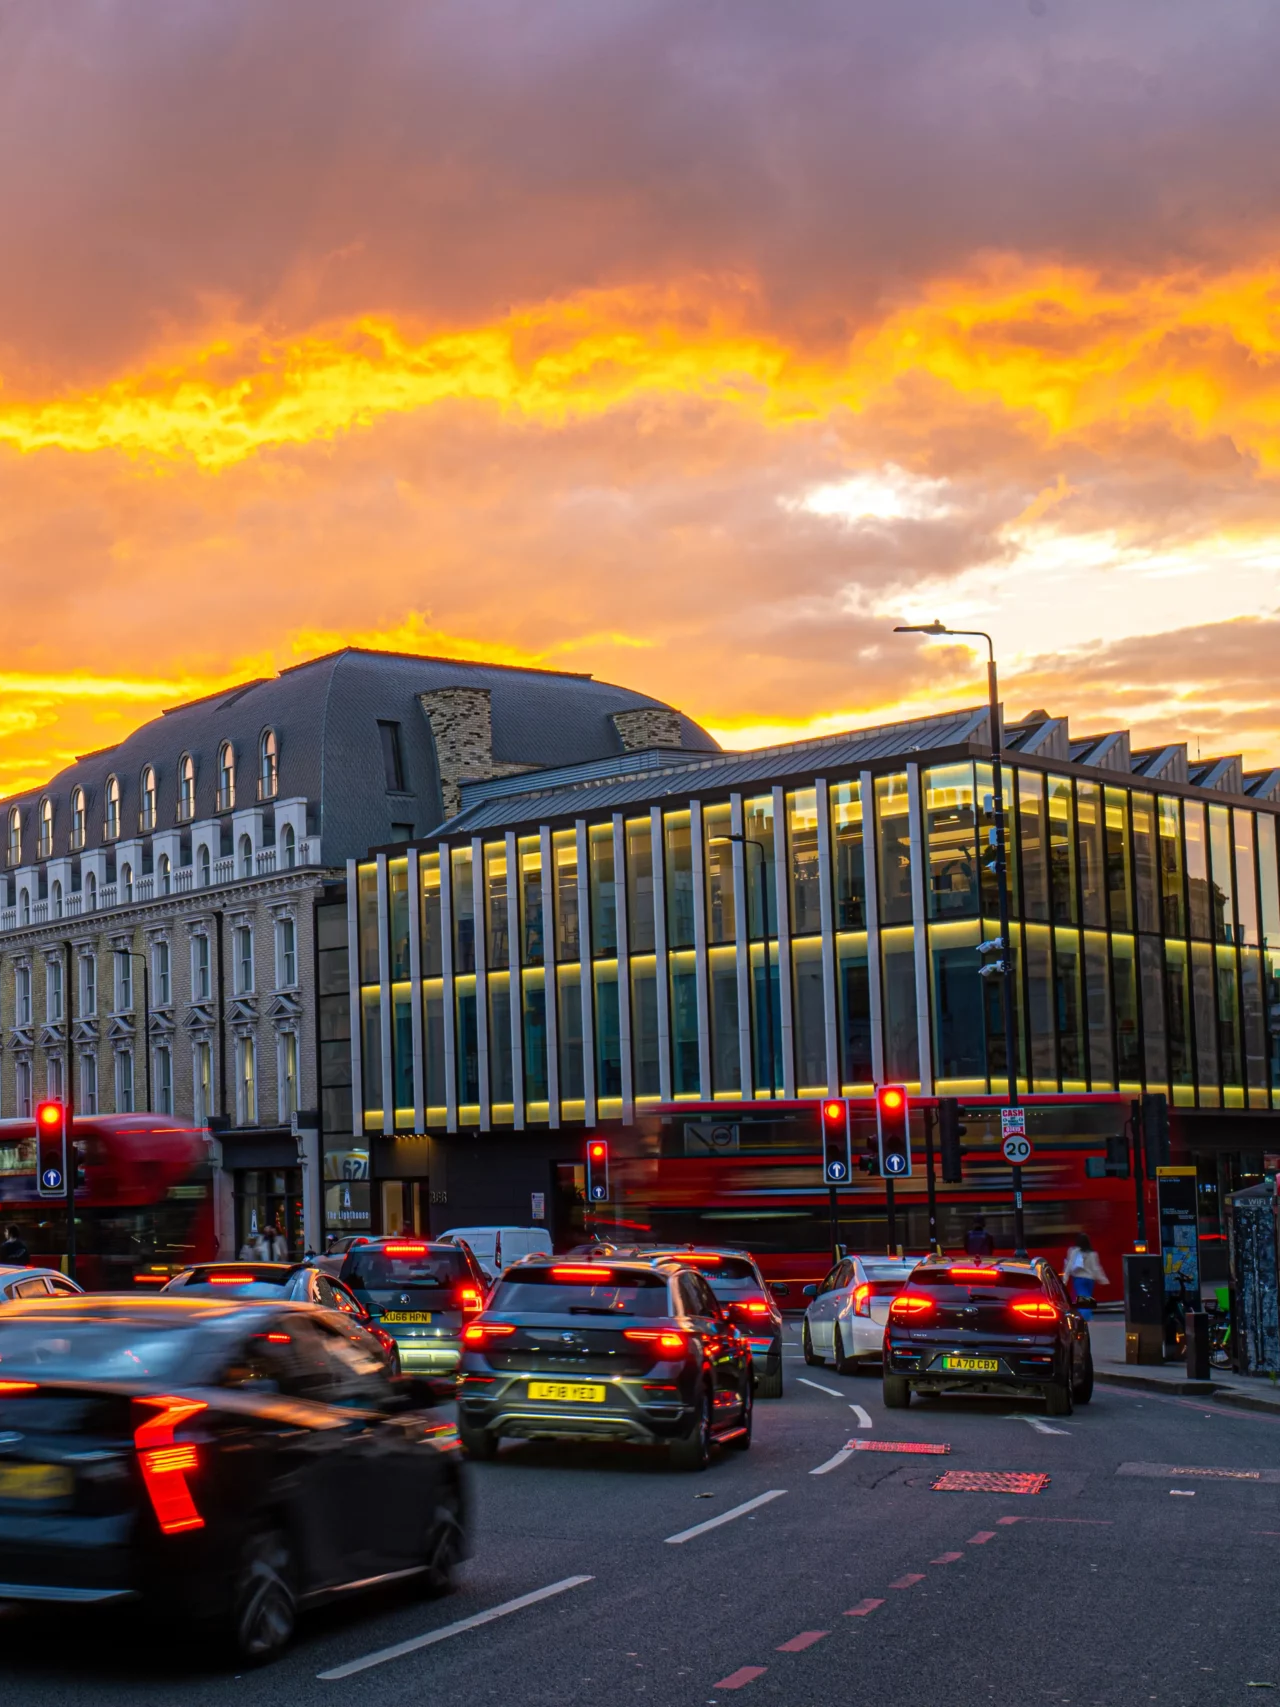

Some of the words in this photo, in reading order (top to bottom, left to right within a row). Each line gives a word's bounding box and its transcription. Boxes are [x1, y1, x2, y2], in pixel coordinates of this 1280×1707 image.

[1002, 1109, 1024, 1117] CASH
[1006, 1142, 1029, 1156] 20
[327, 1211, 337, 1220] The
[338, 1210, 369, 1220] Lighthouse
[383, 1313, 407, 1321] KU66
[409, 1313, 427, 1321] HPN
[949, 1358, 975, 1369] LA70
[977, 1359, 996, 1370] CBX
